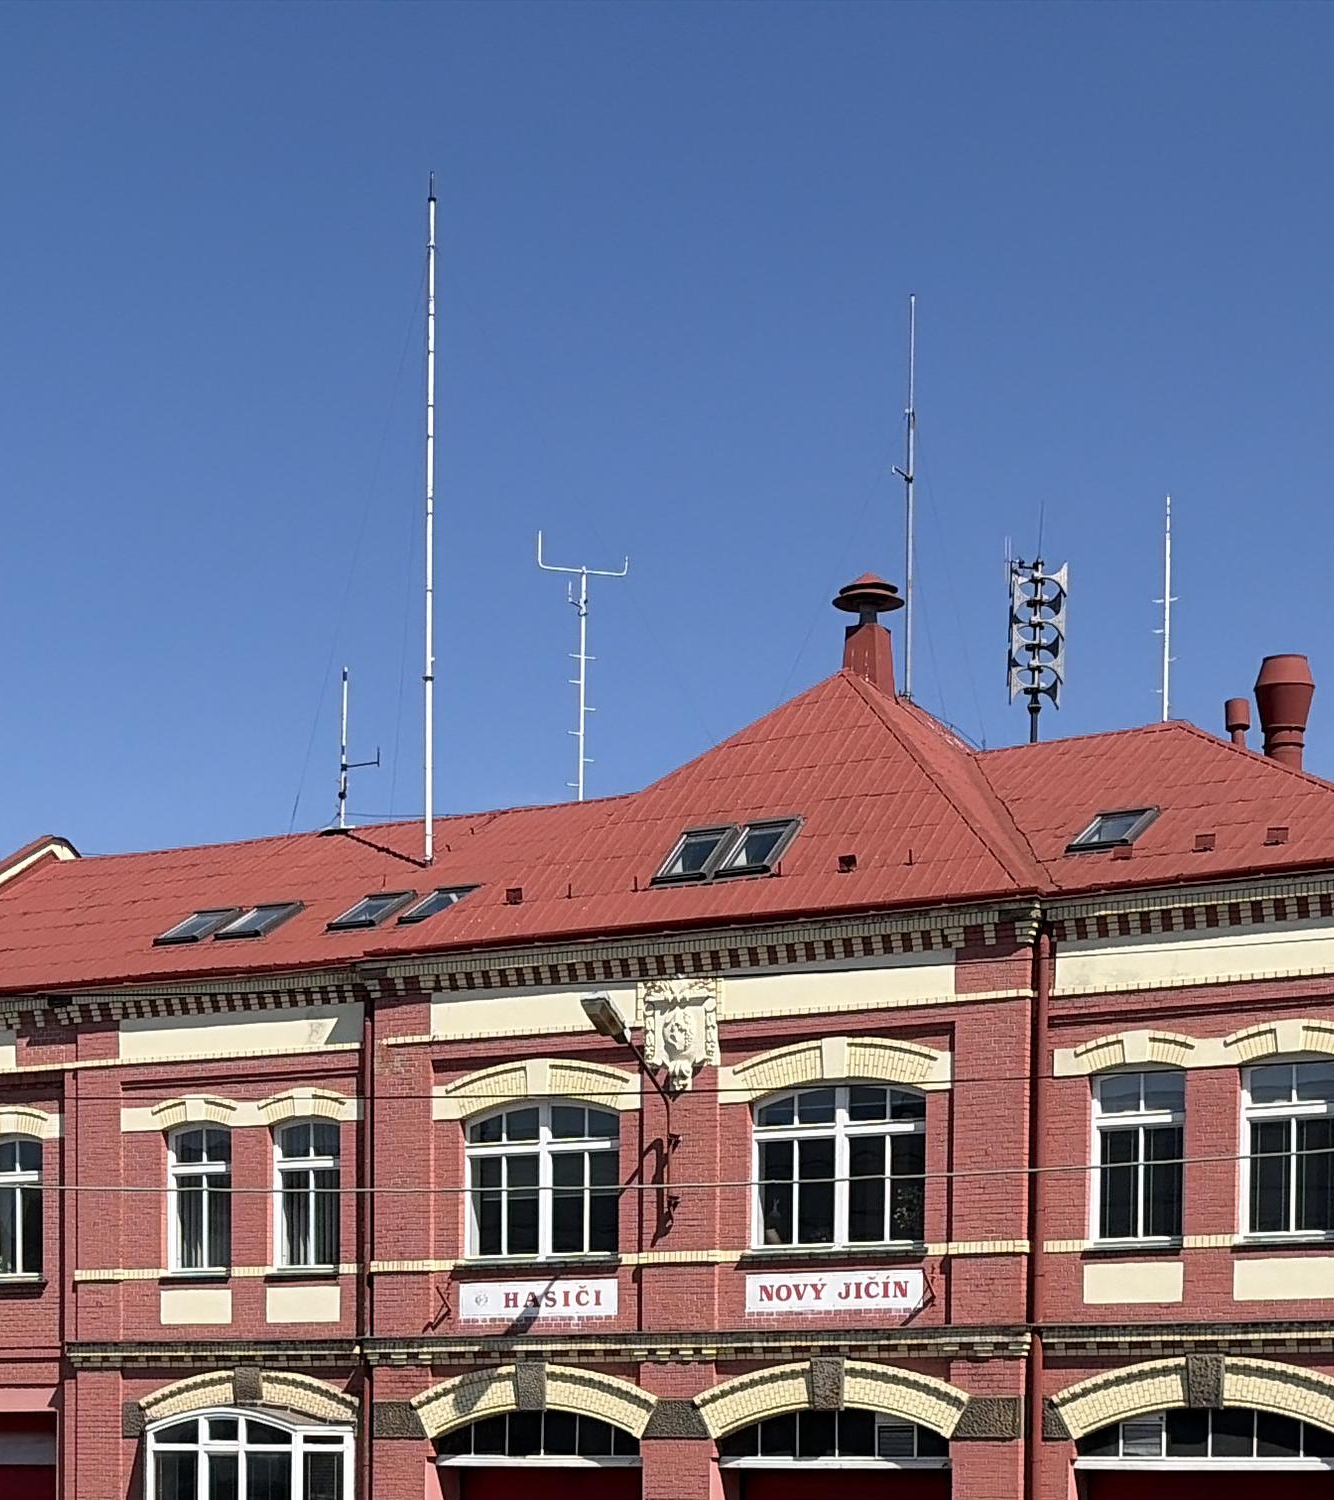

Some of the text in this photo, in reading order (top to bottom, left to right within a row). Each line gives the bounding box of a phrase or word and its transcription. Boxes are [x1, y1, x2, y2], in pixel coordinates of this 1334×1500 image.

[503, 1285, 602, 1309] HASIČI
[758, 1275, 910, 1302] NOVÝ JIČÍN
